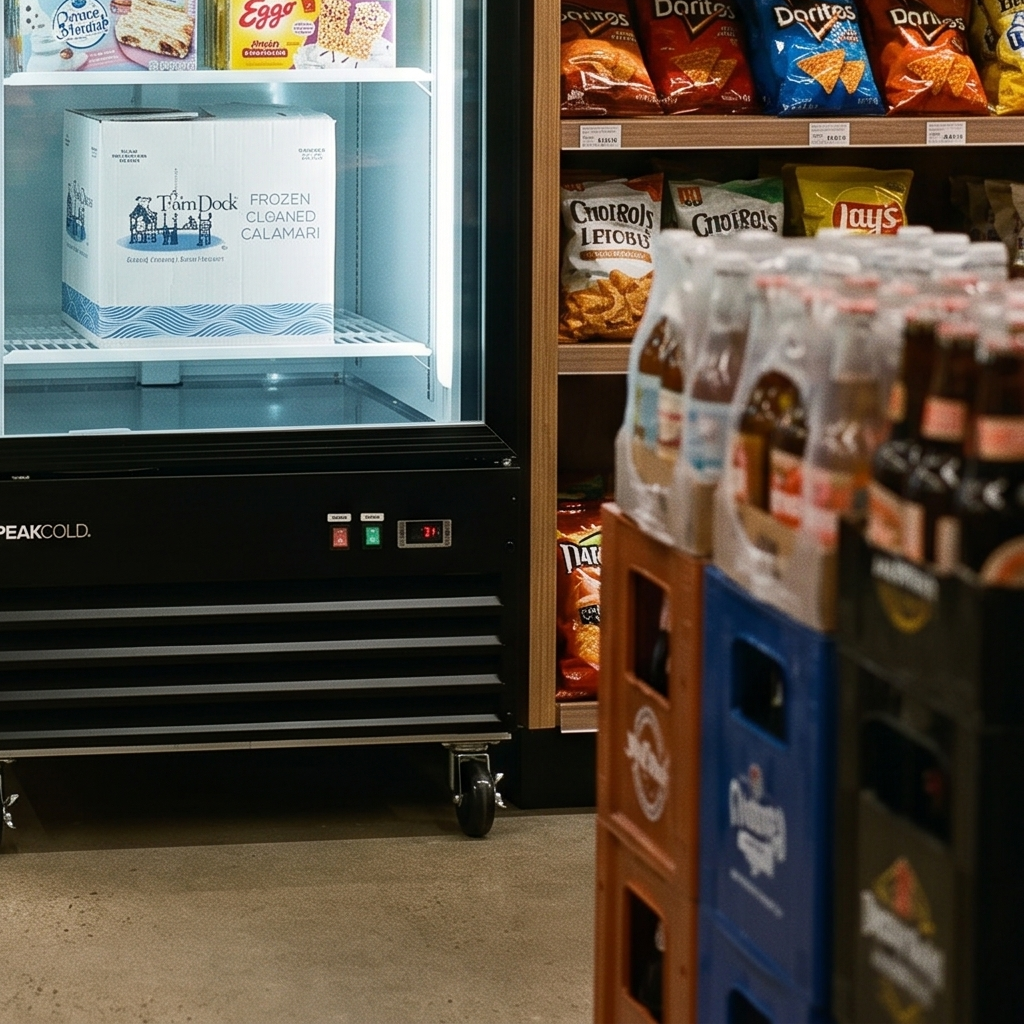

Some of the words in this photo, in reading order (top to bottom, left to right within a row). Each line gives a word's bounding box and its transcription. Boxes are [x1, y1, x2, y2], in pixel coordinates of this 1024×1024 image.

[774, 3, 856, 27] Doritos
[250, 193, 311, 205] FROZEN
[241, 227, 320, 241] CALAMARI
